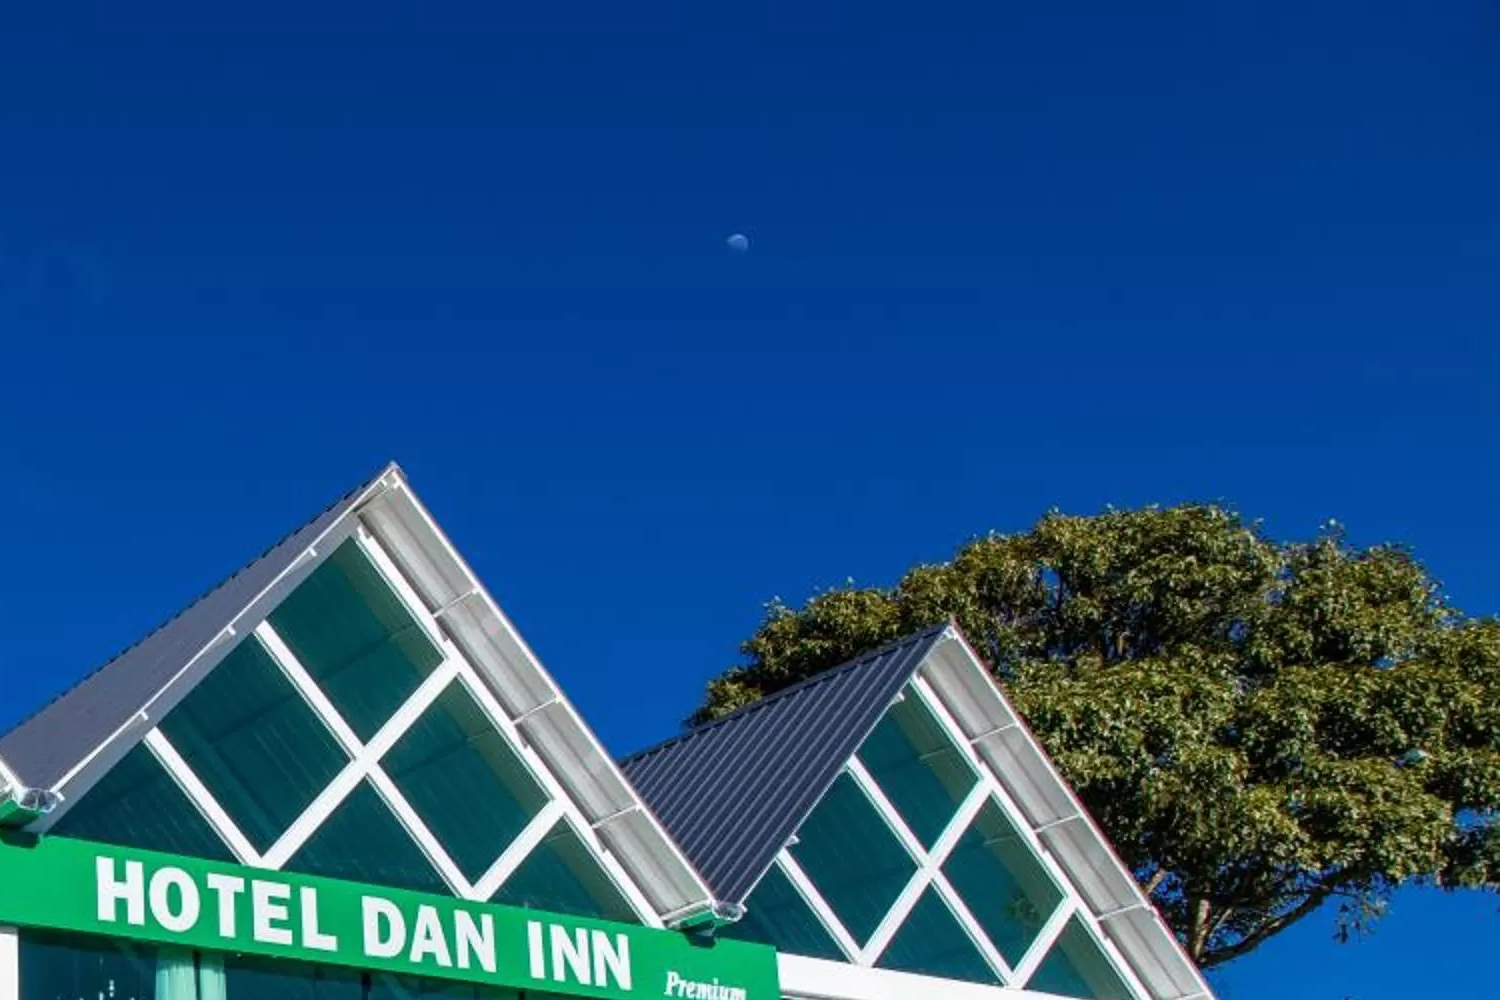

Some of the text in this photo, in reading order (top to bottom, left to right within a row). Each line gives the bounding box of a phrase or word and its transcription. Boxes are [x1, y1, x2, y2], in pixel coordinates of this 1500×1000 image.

[95, 856, 633, 991] HOTEL DAN INN
